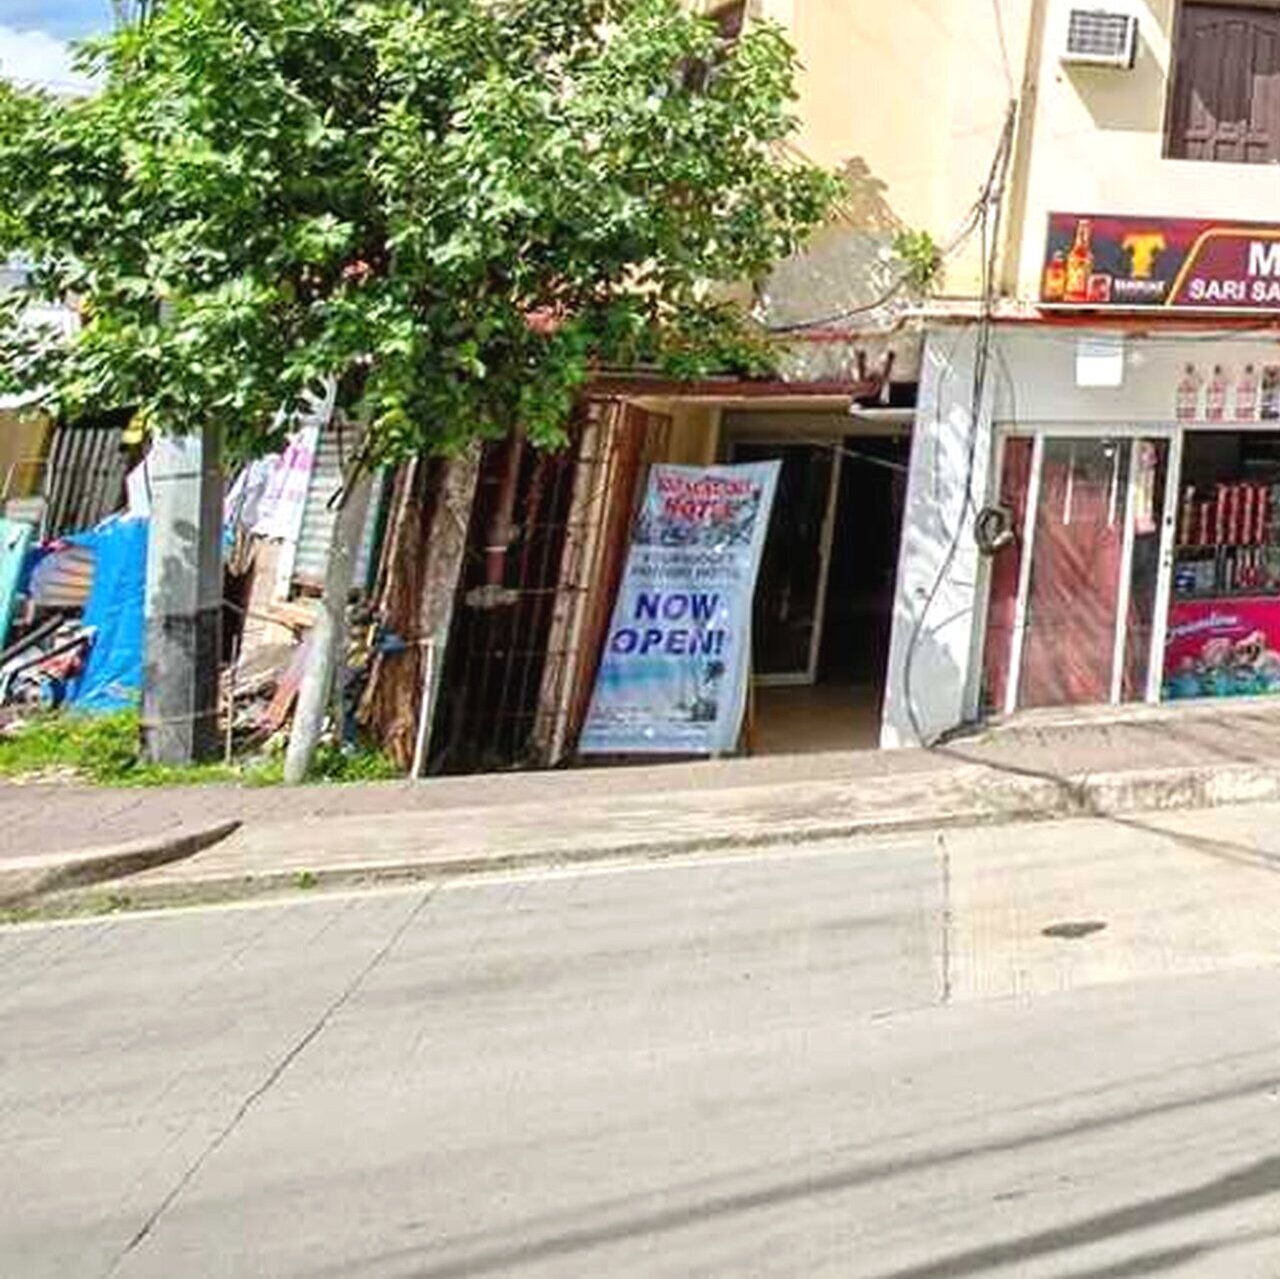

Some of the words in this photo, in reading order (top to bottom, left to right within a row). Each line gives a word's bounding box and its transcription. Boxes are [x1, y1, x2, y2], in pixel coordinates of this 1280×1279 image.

[1189, 277, 1246, 301] SARI
[635, 593, 719, 620] NOW
[610, 628, 725, 656] OPEN!
